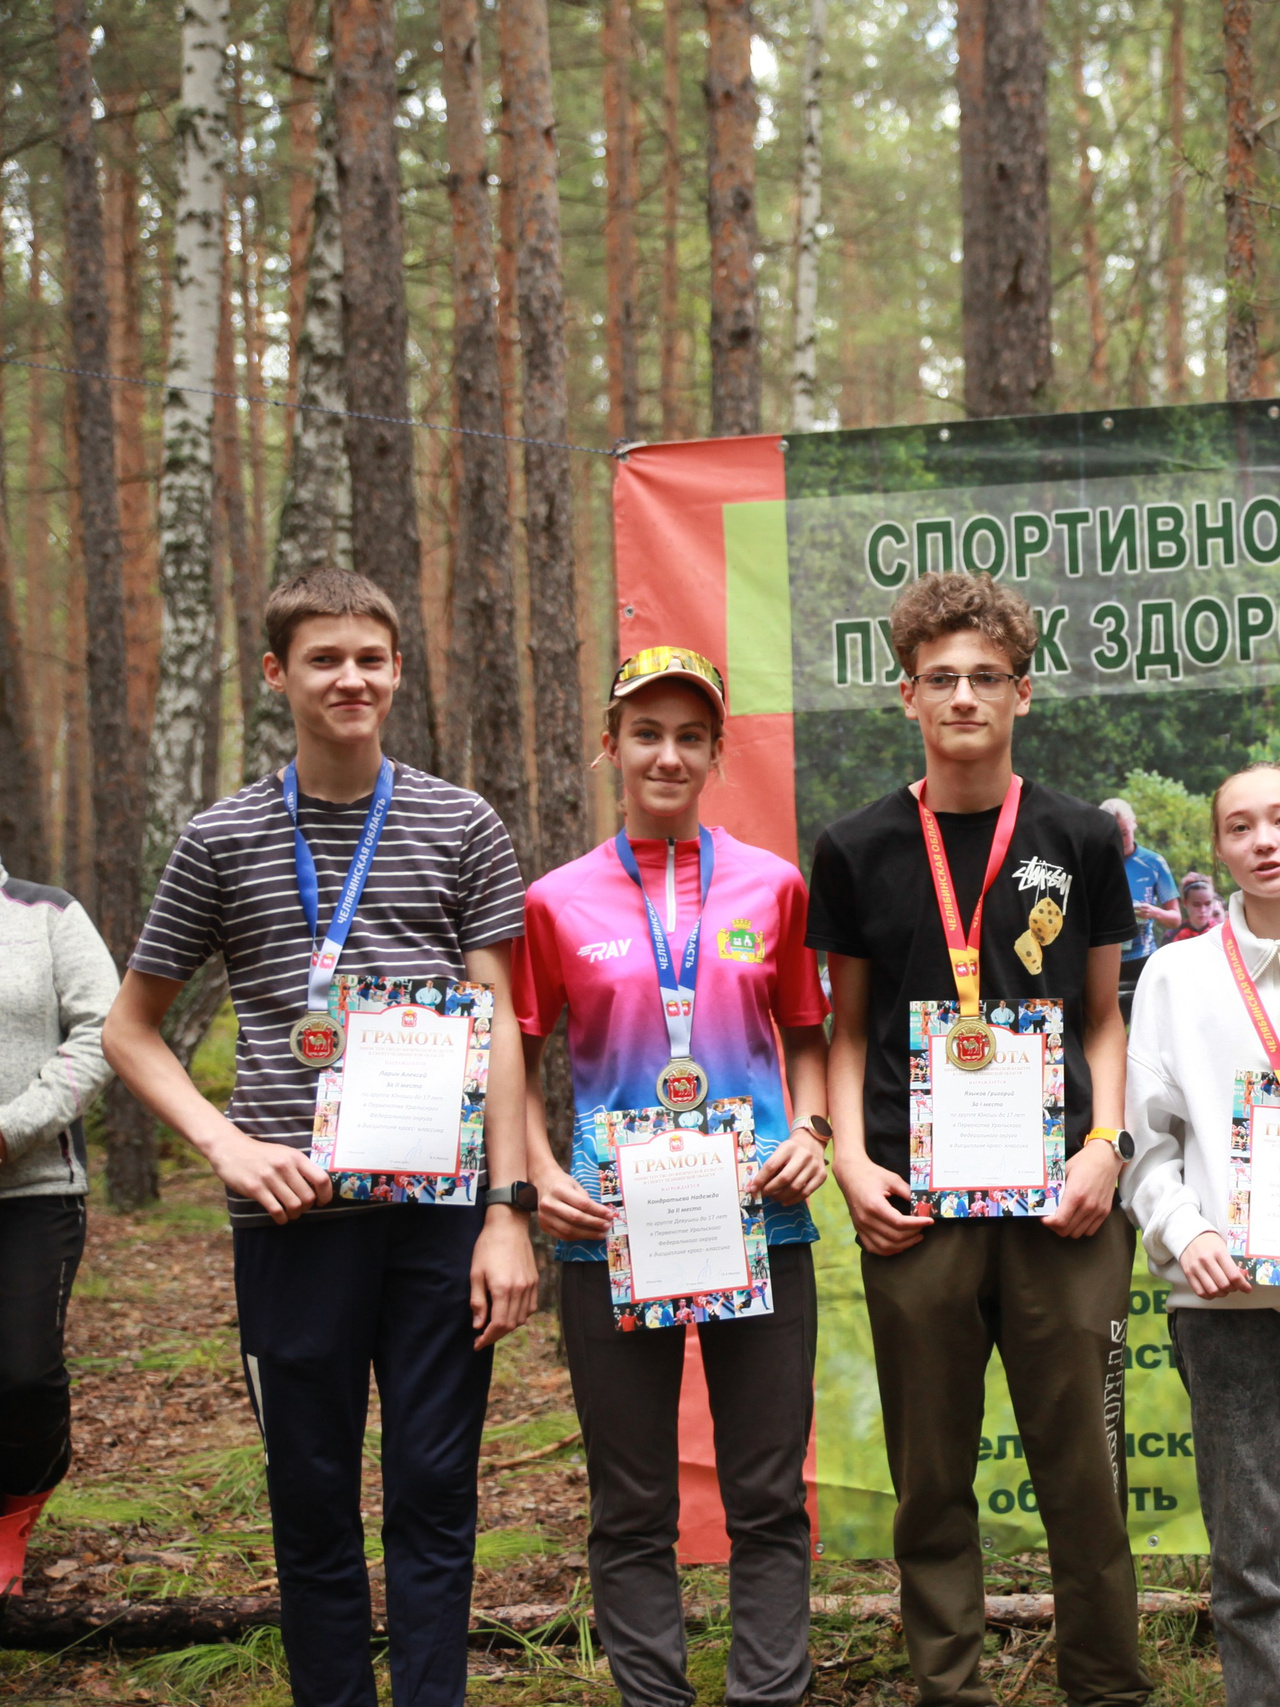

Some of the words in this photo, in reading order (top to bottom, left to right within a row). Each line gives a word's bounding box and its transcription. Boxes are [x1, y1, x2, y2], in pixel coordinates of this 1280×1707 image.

[337, 847, 369, 924] ЧЕЛЯБИНСКАЯ
[364, 798, 386, 846] ОБЛАСТЬ
[934, 854, 957, 931] ЧЕЛЯБИНСКАЯ
[577, 938, 632, 963] RAY
[1226, 938, 1246, 981] ОБЛАСТЬ
[1240, 981, 1277, 1053] ЧЕЛЯБИНСКАЯ
[360, 1029, 454, 1046] ГРАМОТА
[987, 1090, 1015, 1098] Григорий
[634, 1152, 722, 1174] ГРАМОТА
[690, 1192, 720, 1200] Надежда
